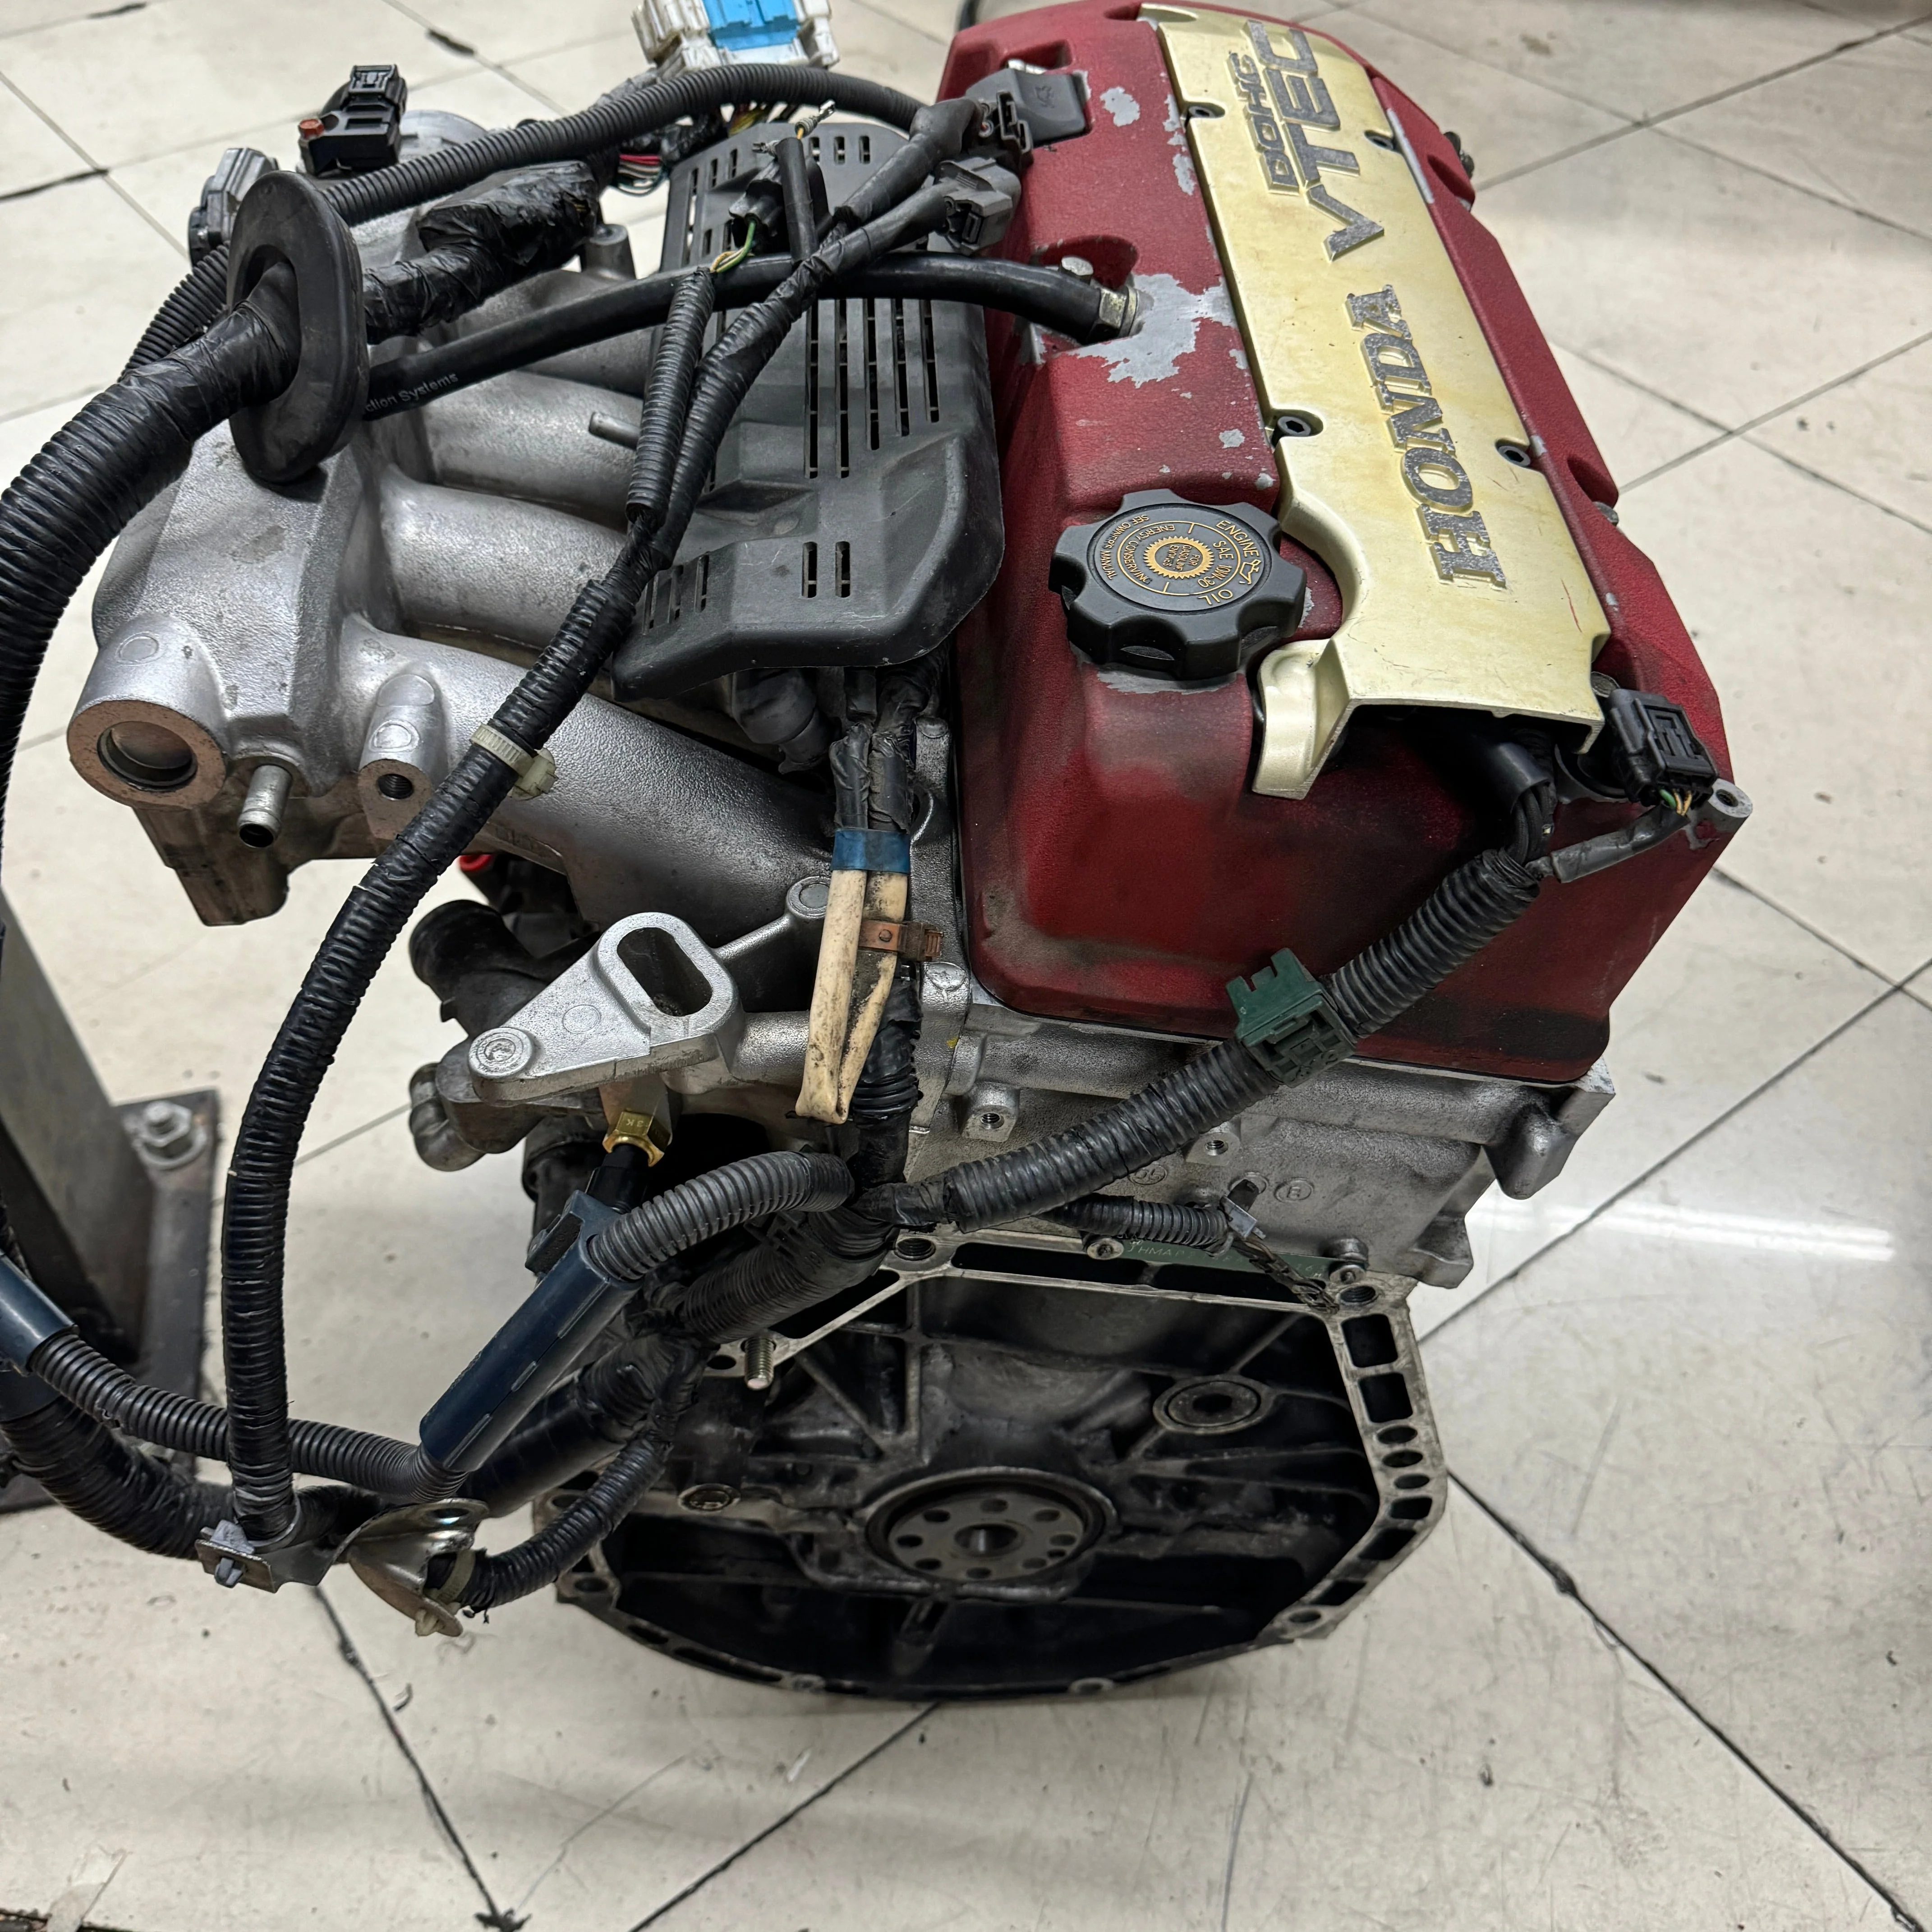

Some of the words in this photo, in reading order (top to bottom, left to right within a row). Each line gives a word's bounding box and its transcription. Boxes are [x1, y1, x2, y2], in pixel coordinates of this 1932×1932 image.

[1224, 51, 1300, 196] DOHC
[1241, 19, 1385, 262] VTEC
[398, 373, 459, 402] Systems
[1344, 284, 1507, 589] HONDA
[1136, 524, 1175, 540] ENERGY
[1216, 520, 1259, 557] ENGINE
[1123, 540, 1153, 584] CONSERVING
[1188, 554, 1201, 566] FOR
[1213, 541, 1234, 559] SAE
[1100, 550, 1118, 580] MANUAL
[1197, 565, 1233, 588] 10W-30
[1197, 589, 1233, 605] OIL
